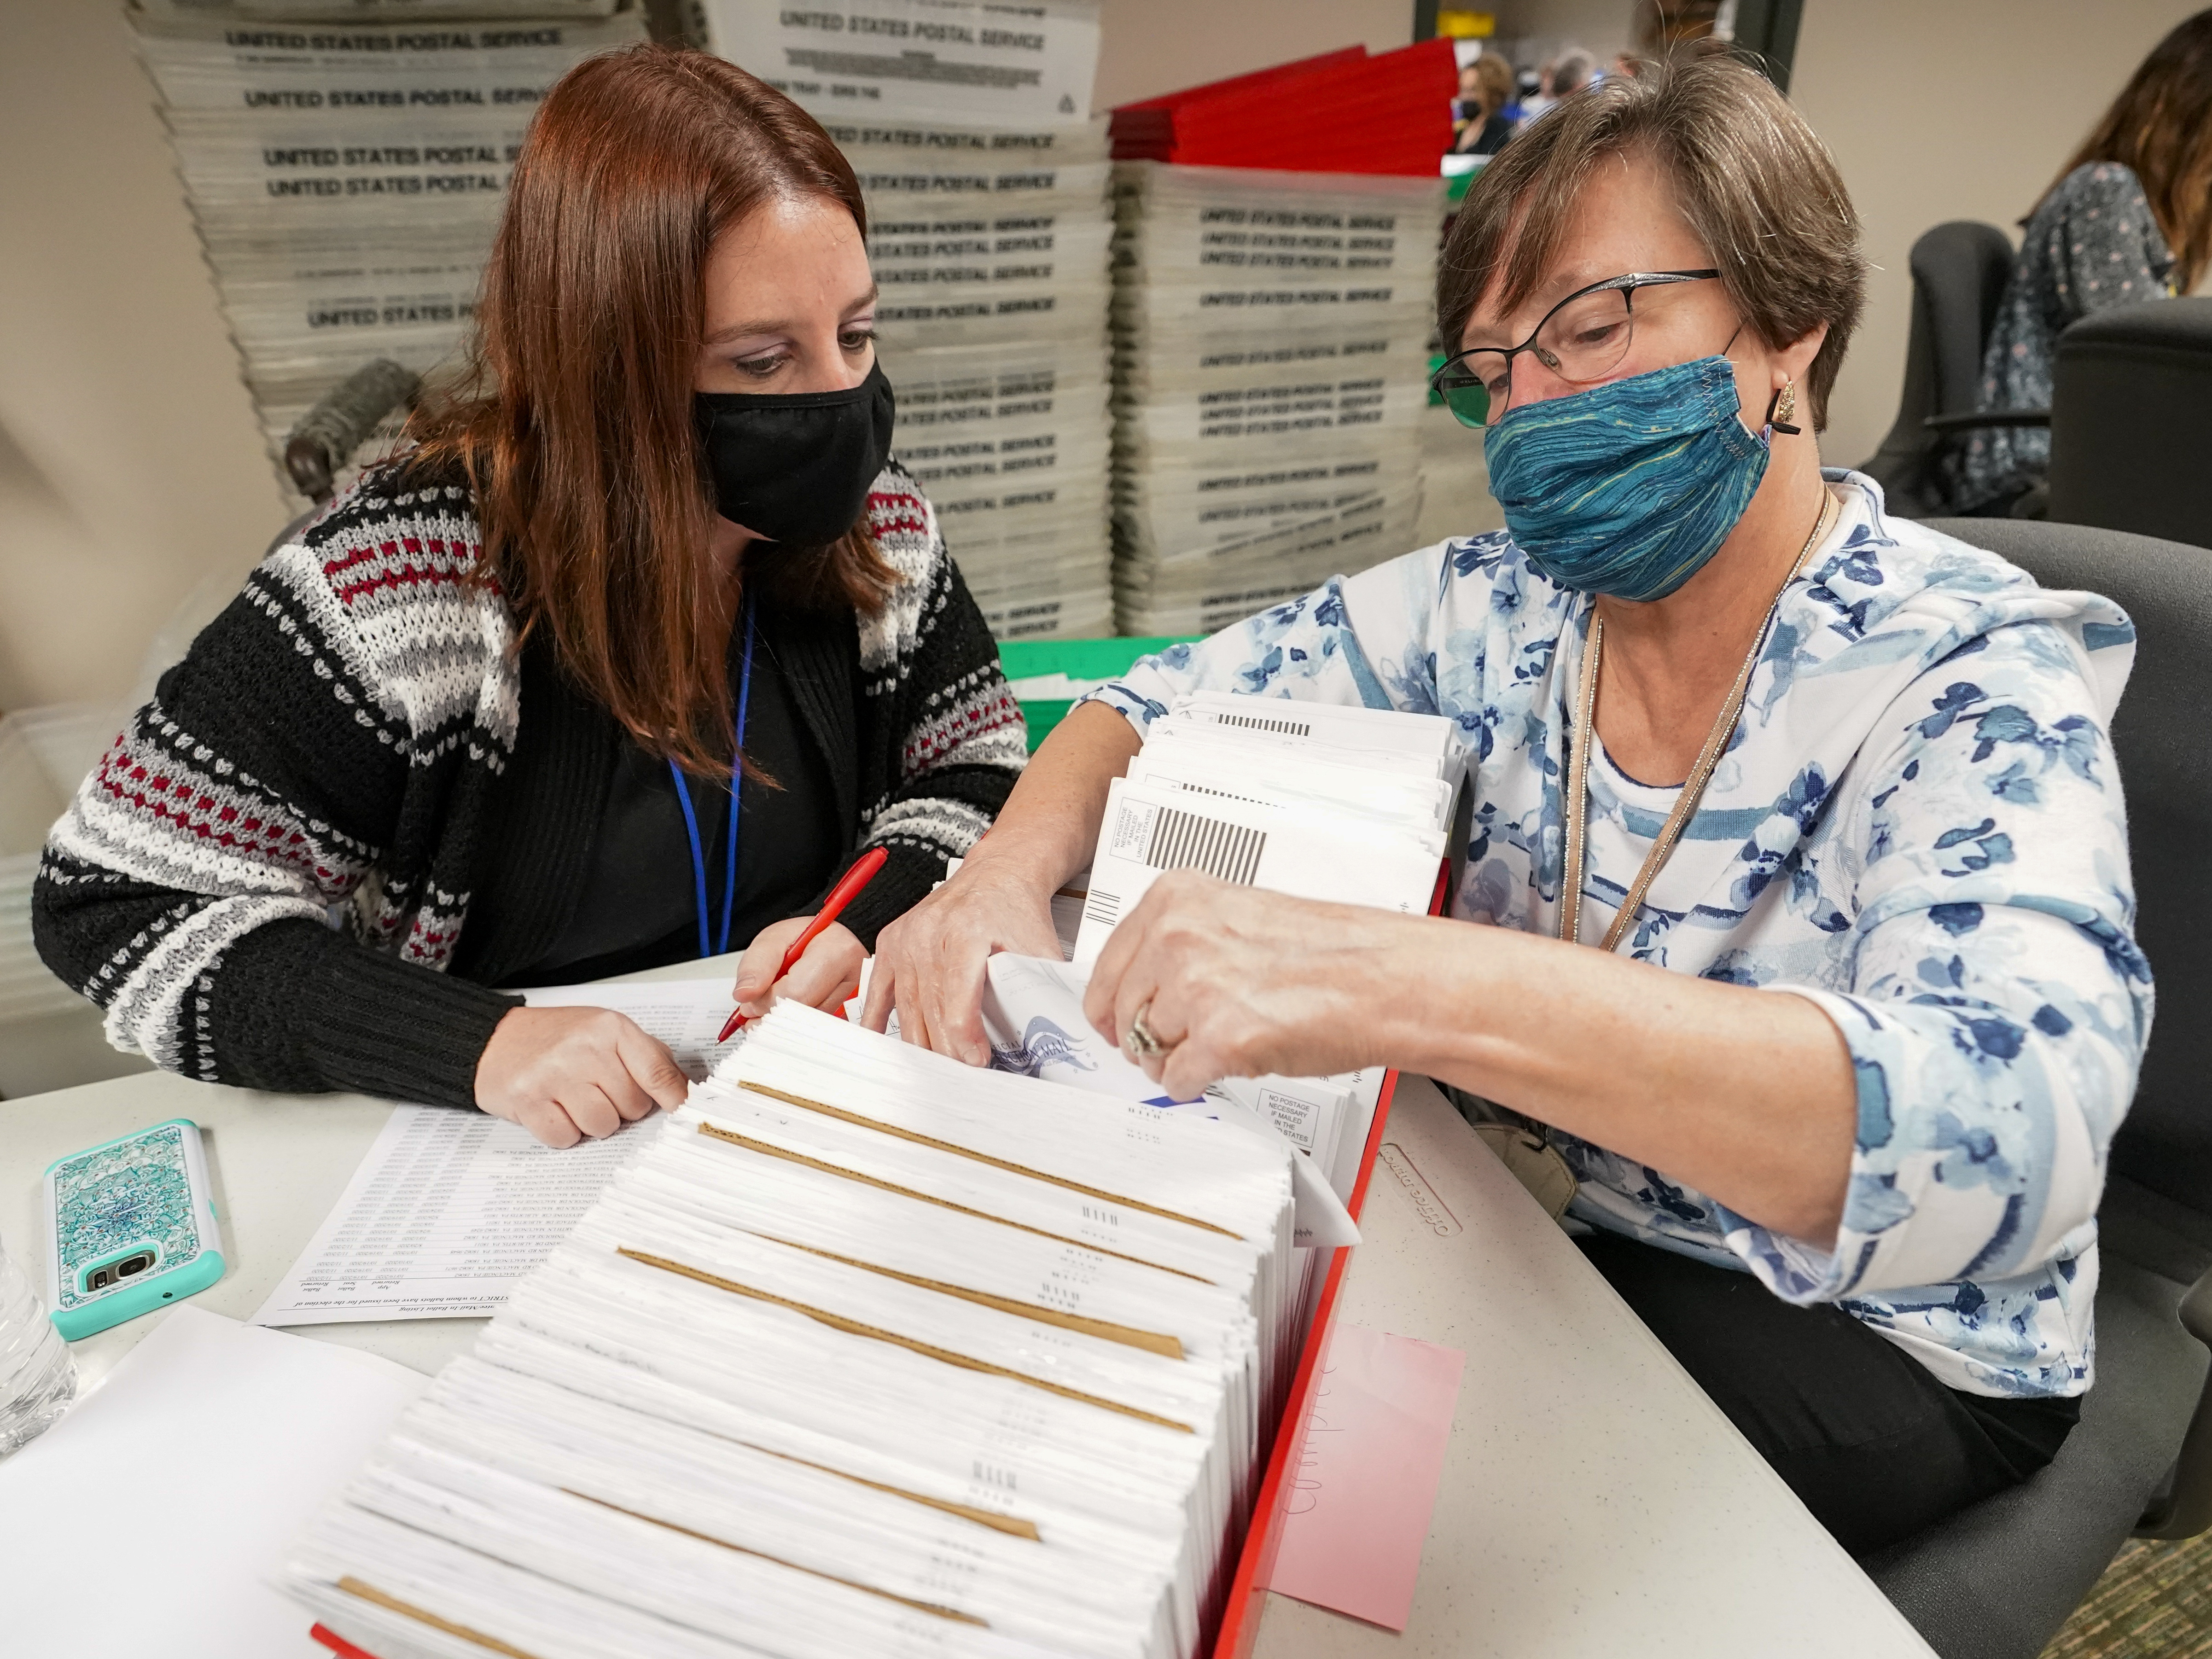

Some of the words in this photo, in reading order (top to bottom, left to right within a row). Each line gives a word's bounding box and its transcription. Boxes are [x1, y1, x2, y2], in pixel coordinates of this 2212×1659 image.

[226, 30, 306, 49] UNITED
[311, 32, 392, 52] STATES
[396, 32, 475, 51] POSTAL
[479, 28, 562, 48] SERVICE
[780, 11, 844, 31] UNITED
[849, 15, 909, 38] STATES
[913, 21, 973, 44] POSTAL
[980, 28, 1045, 51] SERVICE
[244, 91, 323, 108] UNITED
[330, 91, 404, 108] STATES
[410, 89, 486, 107] POSTAL
[862, 128, 921, 146] STATES
[926, 131, 985, 150] POSTAL
[991, 134, 1054, 150] SERVICE
[263, 148, 338, 167] UNITED
[343, 147, 419, 166] STATES
[424, 146, 499, 165] POSTAL
[267, 178, 342, 198] UNITED
[347, 178, 422, 196] STATES
[426, 175, 500, 193] POSTAL
[869, 174, 927, 191] STATES
[932, 175, 989, 192] POSTAL
[995, 172, 1054, 191] SERVICE
[873, 242, 930, 257] STATES
[934, 240, 989, 256] POSTAL
[996, 235, 1054, 253] SERVICE
[307, 308, 378, 330] UNITED
[383, 305, 455, 325] STATES
[1114, 838, 1120, 847] NO
[1117, 807, 1127, 837] POSTAGE
[1121, 810, 1133, 848] NECESSARY
[1129, 815, 1138, 838] MAILED
[1137, 834, 1146, 857] UNITED
[1143, 809, 1153, 833] STATES
[1041, 1038, 1071, 1058] MAIL
[1269, 1102, 1307, 1118] NECESSARY
[1280, 1098, 1310, 1112] POSTAGE
[1278, 1112, 1302, 1124] MAILED
[1283, 1122, 1295, 1130] THE
[1284, 1130, 1308, 1142] STATES
